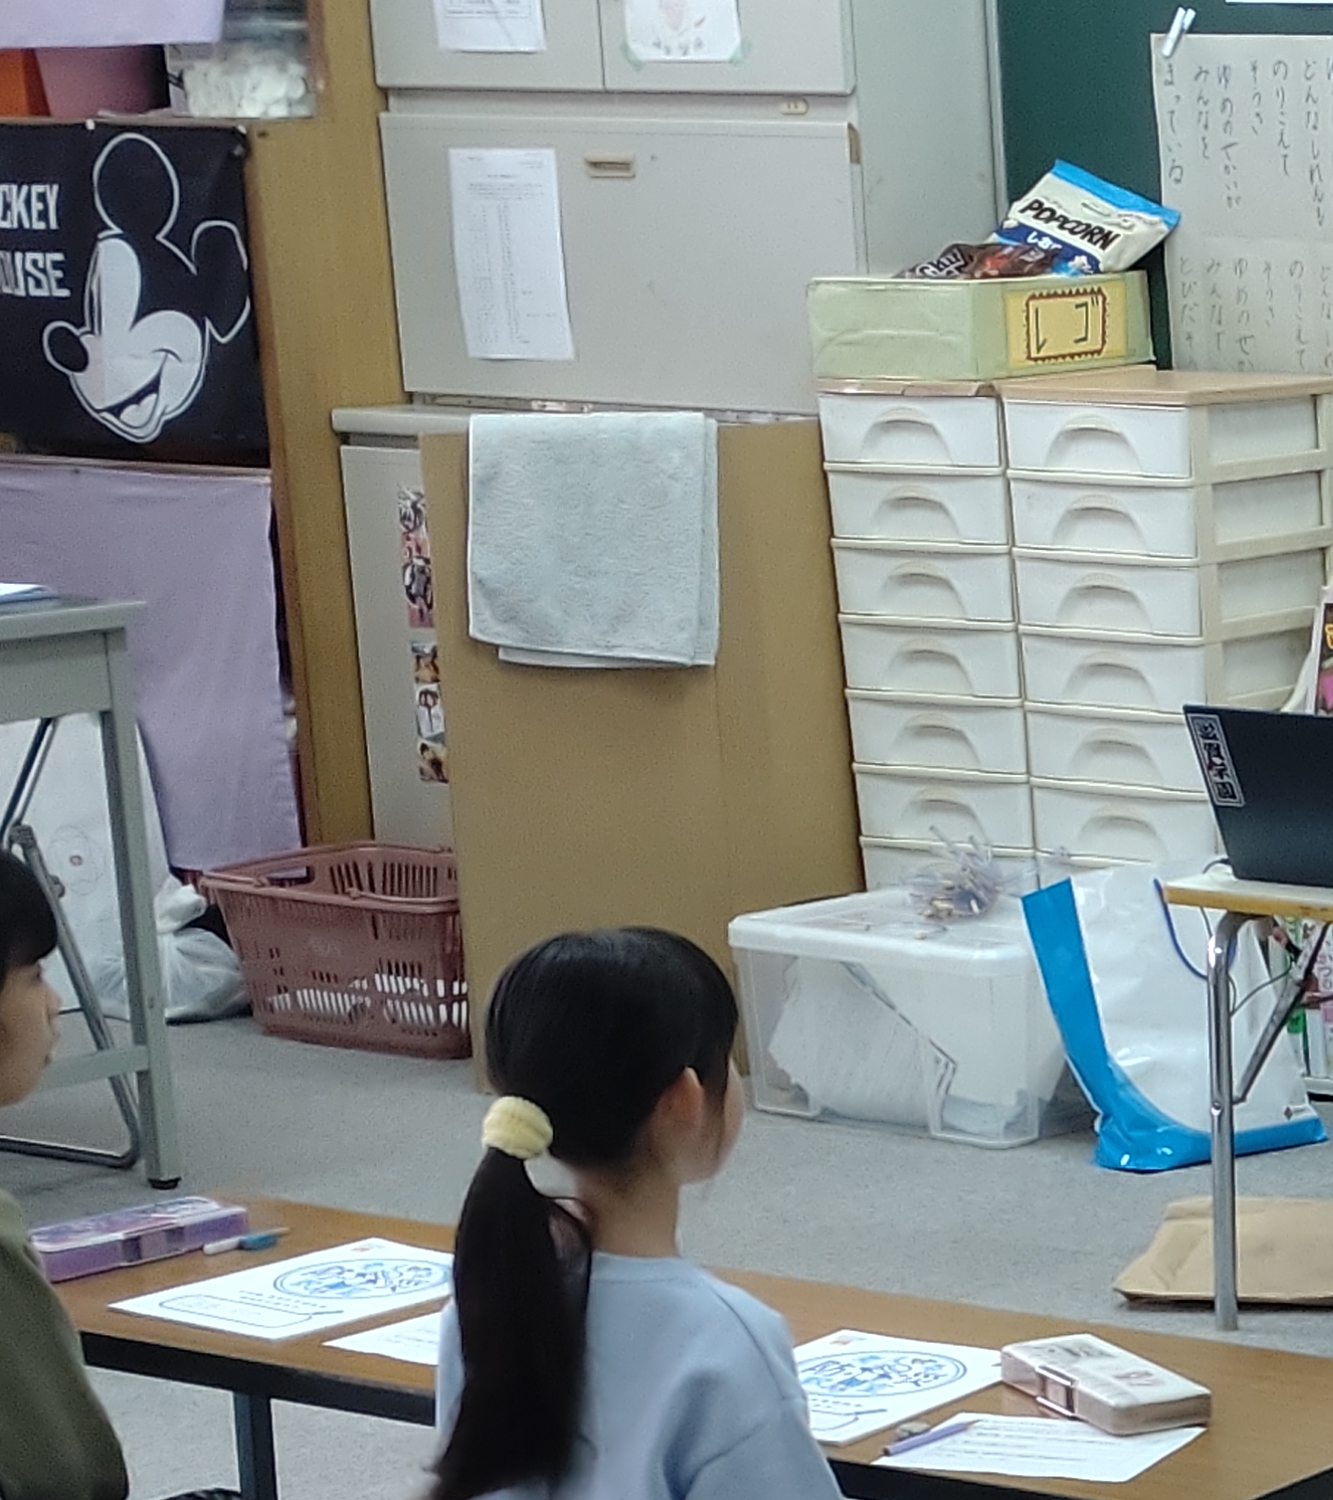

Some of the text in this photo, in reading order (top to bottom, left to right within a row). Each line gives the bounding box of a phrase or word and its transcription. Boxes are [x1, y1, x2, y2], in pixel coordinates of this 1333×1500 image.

[1163, 61, 1184, 185] まっている
[1020, 199, 1121, 251] POPCORN
